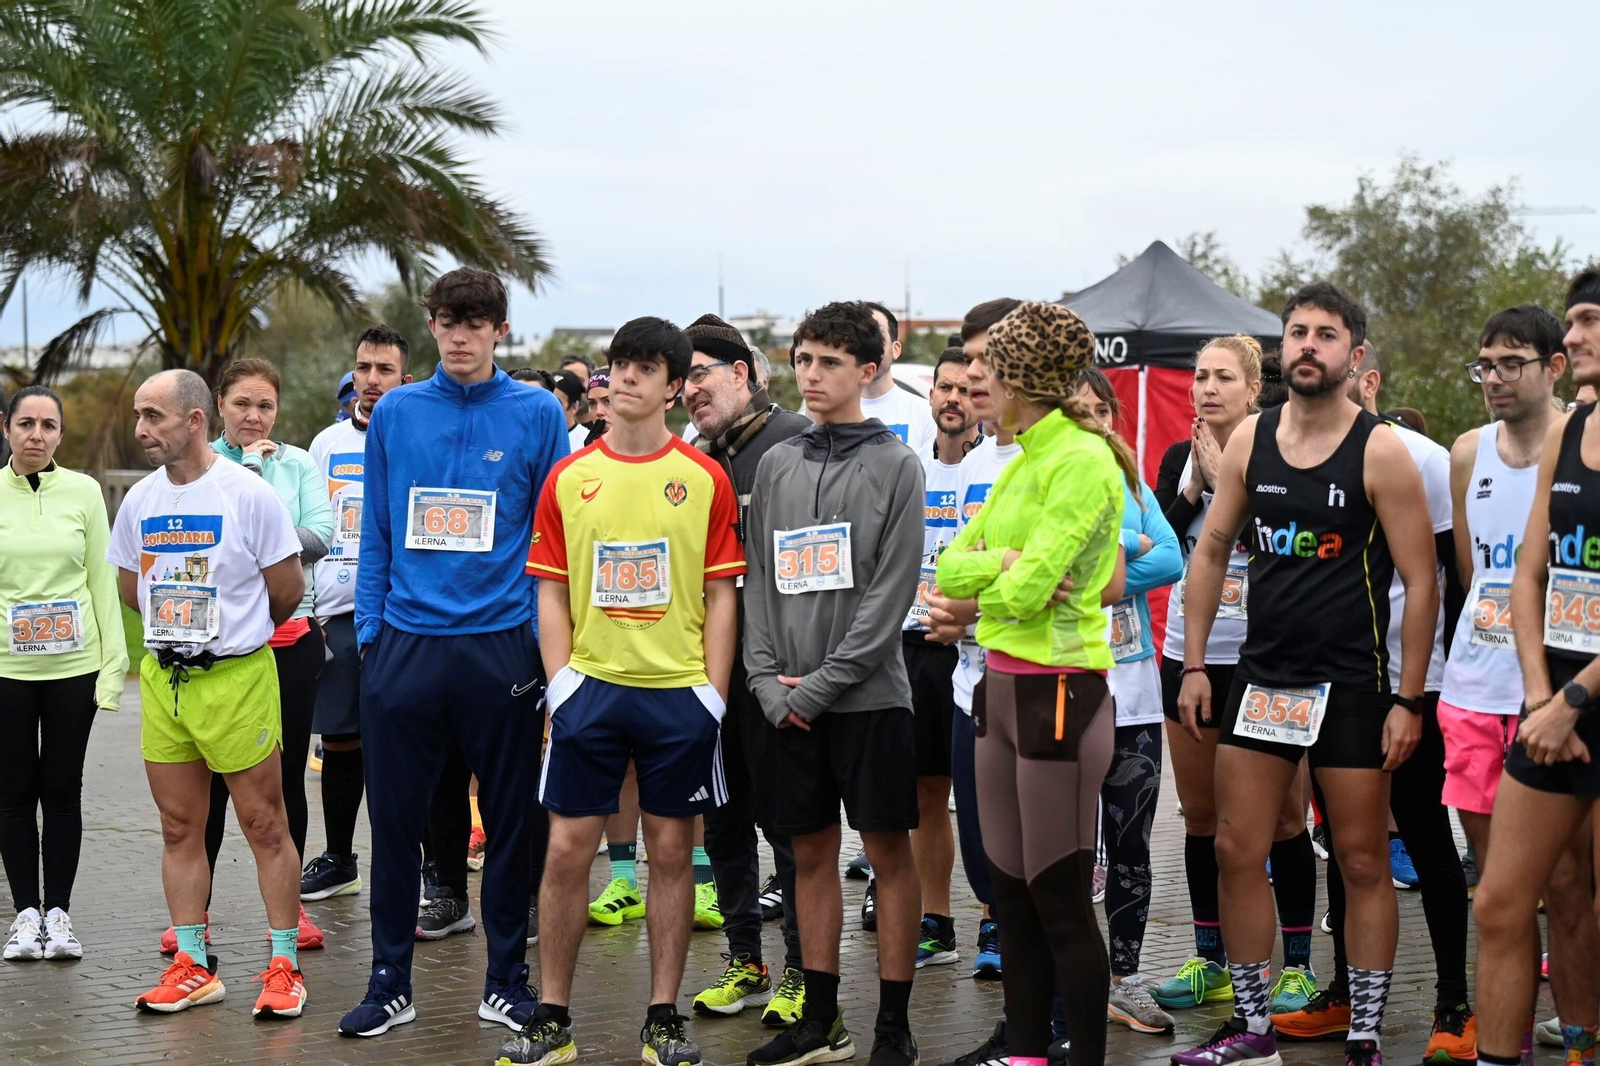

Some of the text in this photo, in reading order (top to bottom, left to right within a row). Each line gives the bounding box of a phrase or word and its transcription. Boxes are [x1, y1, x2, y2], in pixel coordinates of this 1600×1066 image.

[1095, 336, 1128, 364] NO
[940, 494, 956, 505] 12
[1328, 483, 1345, 508] in
[167, 518, 183, 530] 12
[342, 508, 362, 530] 1
[424, 506, 469, 535] 68
[1255, 517, 1343, 559] indea
[598, 559, 658, 591] 185
[778, 544, 838, 579] 315
[157, 599, 193, 627] 41
[1549, 591, 1600, 633] 349
[13, 614, 74, 642] 325
[1244, 691, 1312, 728] 354
